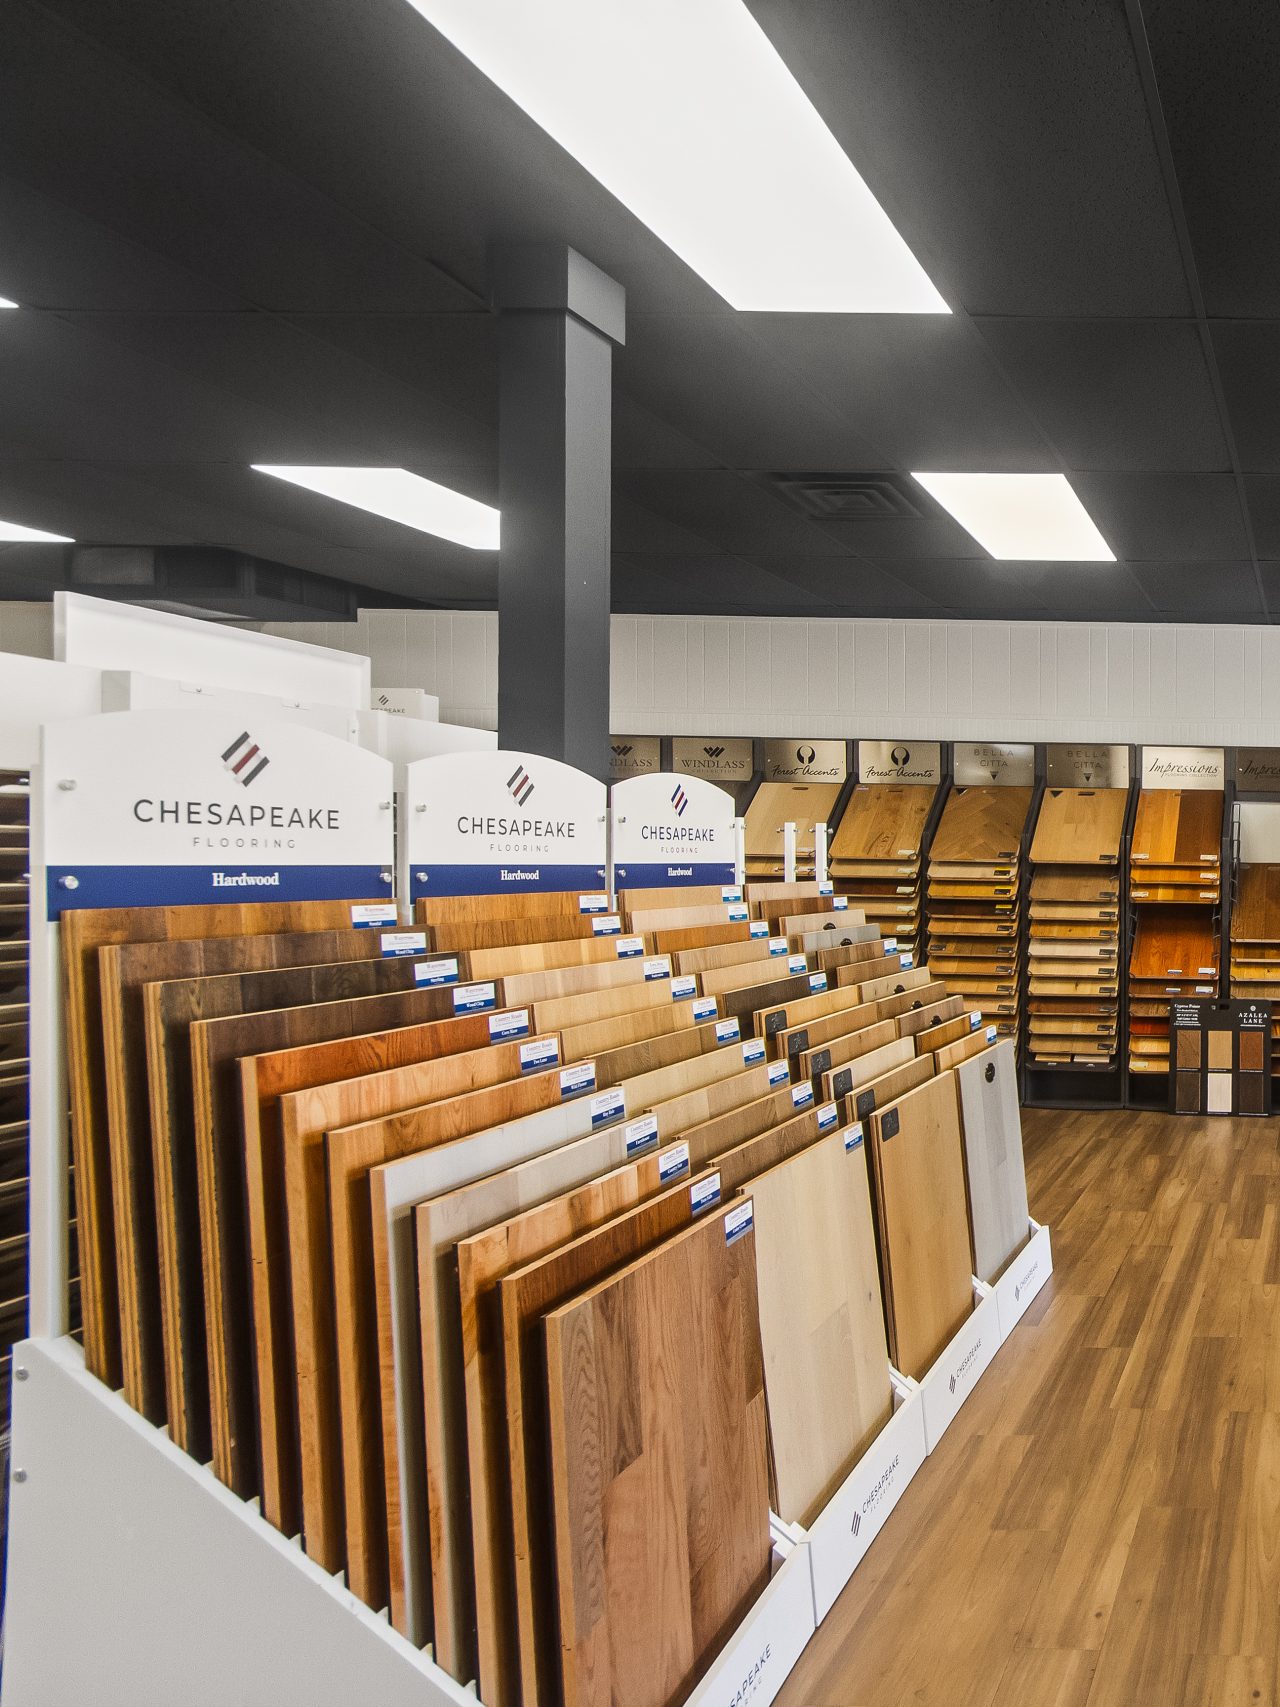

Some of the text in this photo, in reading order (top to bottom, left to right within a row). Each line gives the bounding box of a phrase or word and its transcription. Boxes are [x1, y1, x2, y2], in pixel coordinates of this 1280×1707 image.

[973, 749, 1014, 757] BELLA
[1067, 750, 1108, 758] BELLA
[681, 758, 746, 769] WINDLASS
[979, 759, 1008, 768] CITTA
[1073, 761, 1102, 769] CITTA
[1149, 757, 1219, 778] Impressions
[771, 764, 840, 777] Forest Accents
[864, 766, 935, 779] Forest Accents
[133, 799, 340, 830] CHESAPEAKE
[457, 816, 576, 839] CHESAPEAKE
[641, 825, 715, 843] CHESAPEAKE
[192, 837, 296, 849] FLOORING
[489, 844, 549, 854] FLOORING
[660, 846, 699, 854] FLOORING
[500, 869, 540, 882] Hardwood
[667, 867, 693, 877] Hardwood
[212, 872, 279, 887] Hardwood
[956, 1338, 982, 1378] CHESAPEAKE
[862, 1454, 899, 1514] CHESAPEAKE
[728, 1643, 771, 1707] SAPEAKE
